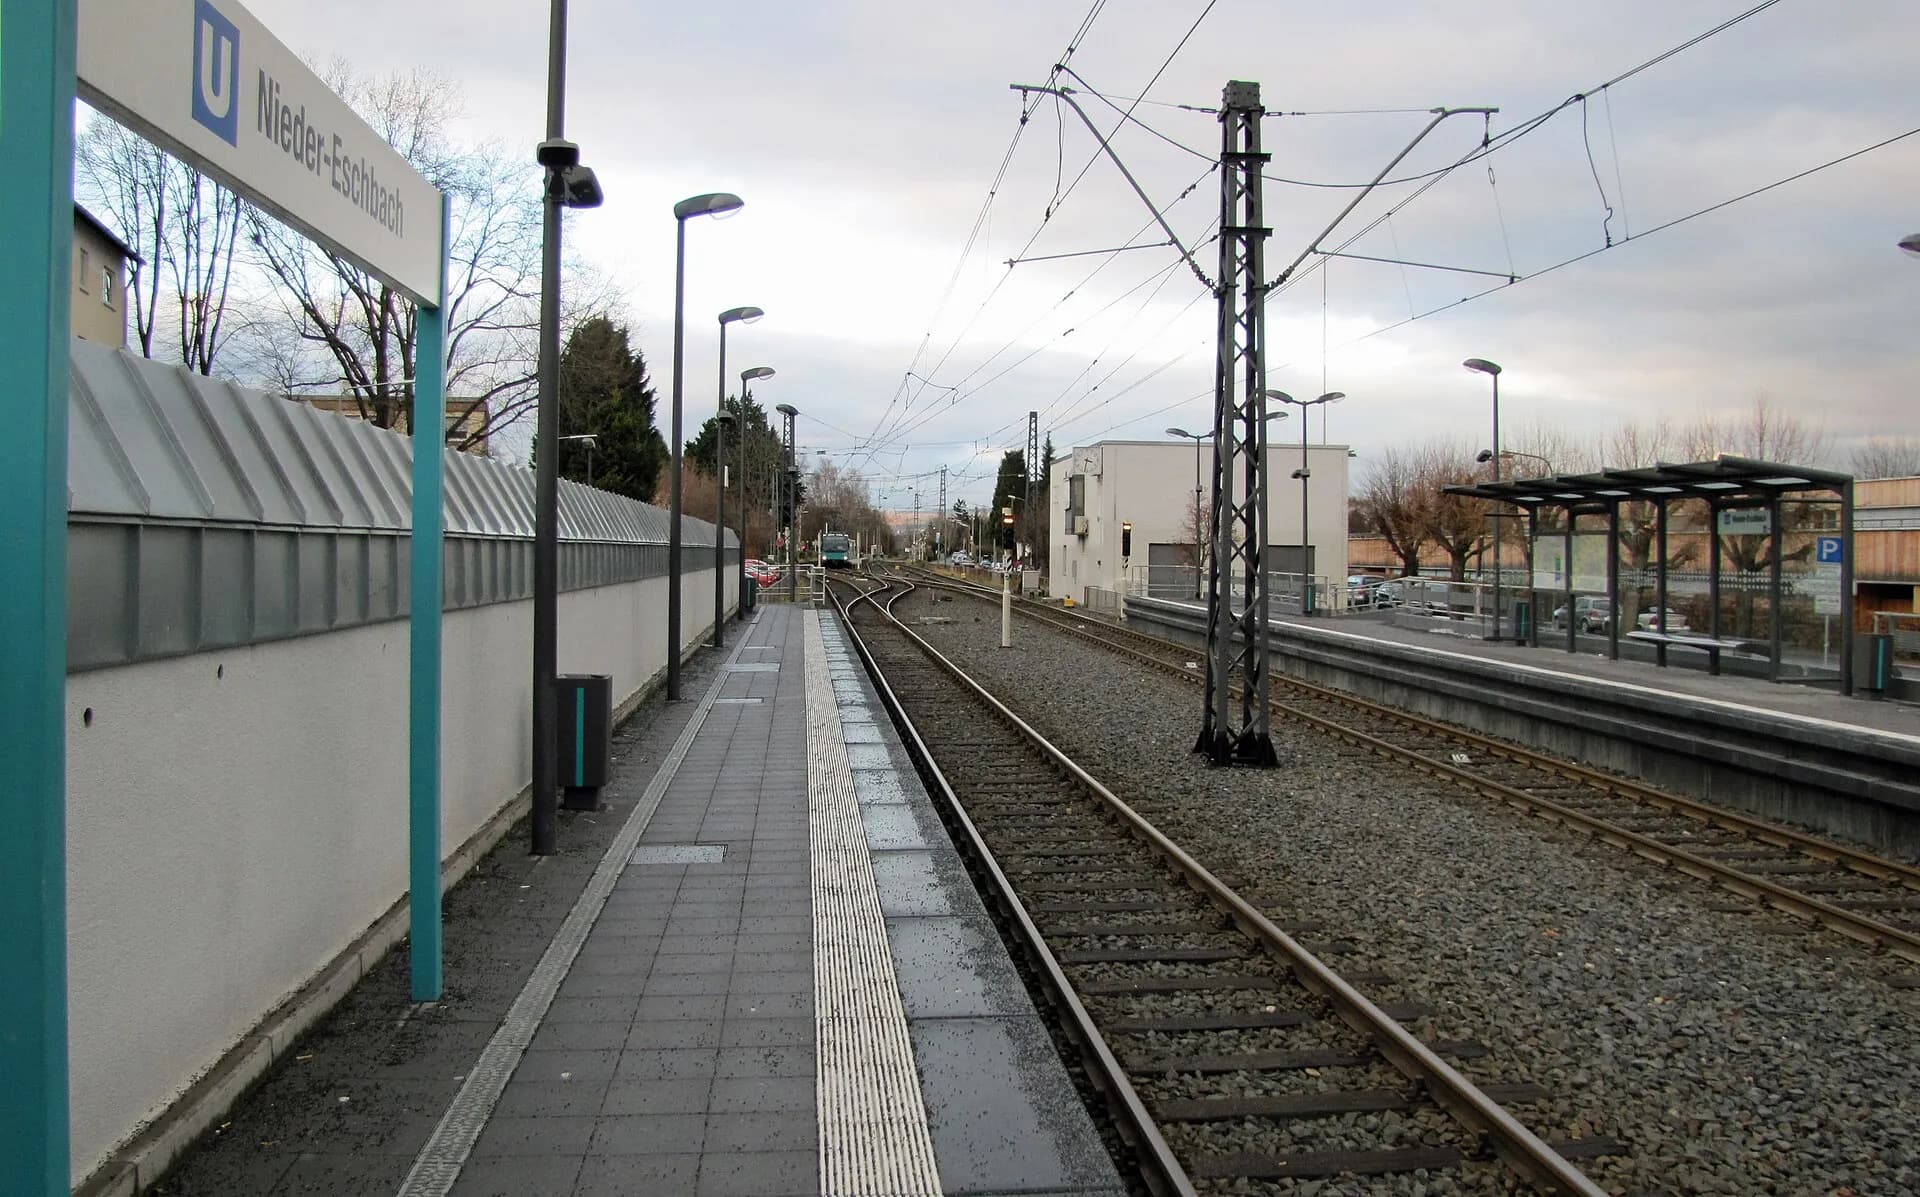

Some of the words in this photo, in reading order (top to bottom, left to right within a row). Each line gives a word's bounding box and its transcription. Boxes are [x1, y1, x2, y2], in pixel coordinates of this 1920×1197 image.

[202, 19, 232, 118] U
[257, 68, 404, 238] Nieder-Eschbach
[1822, 540, 1838, 560] P
